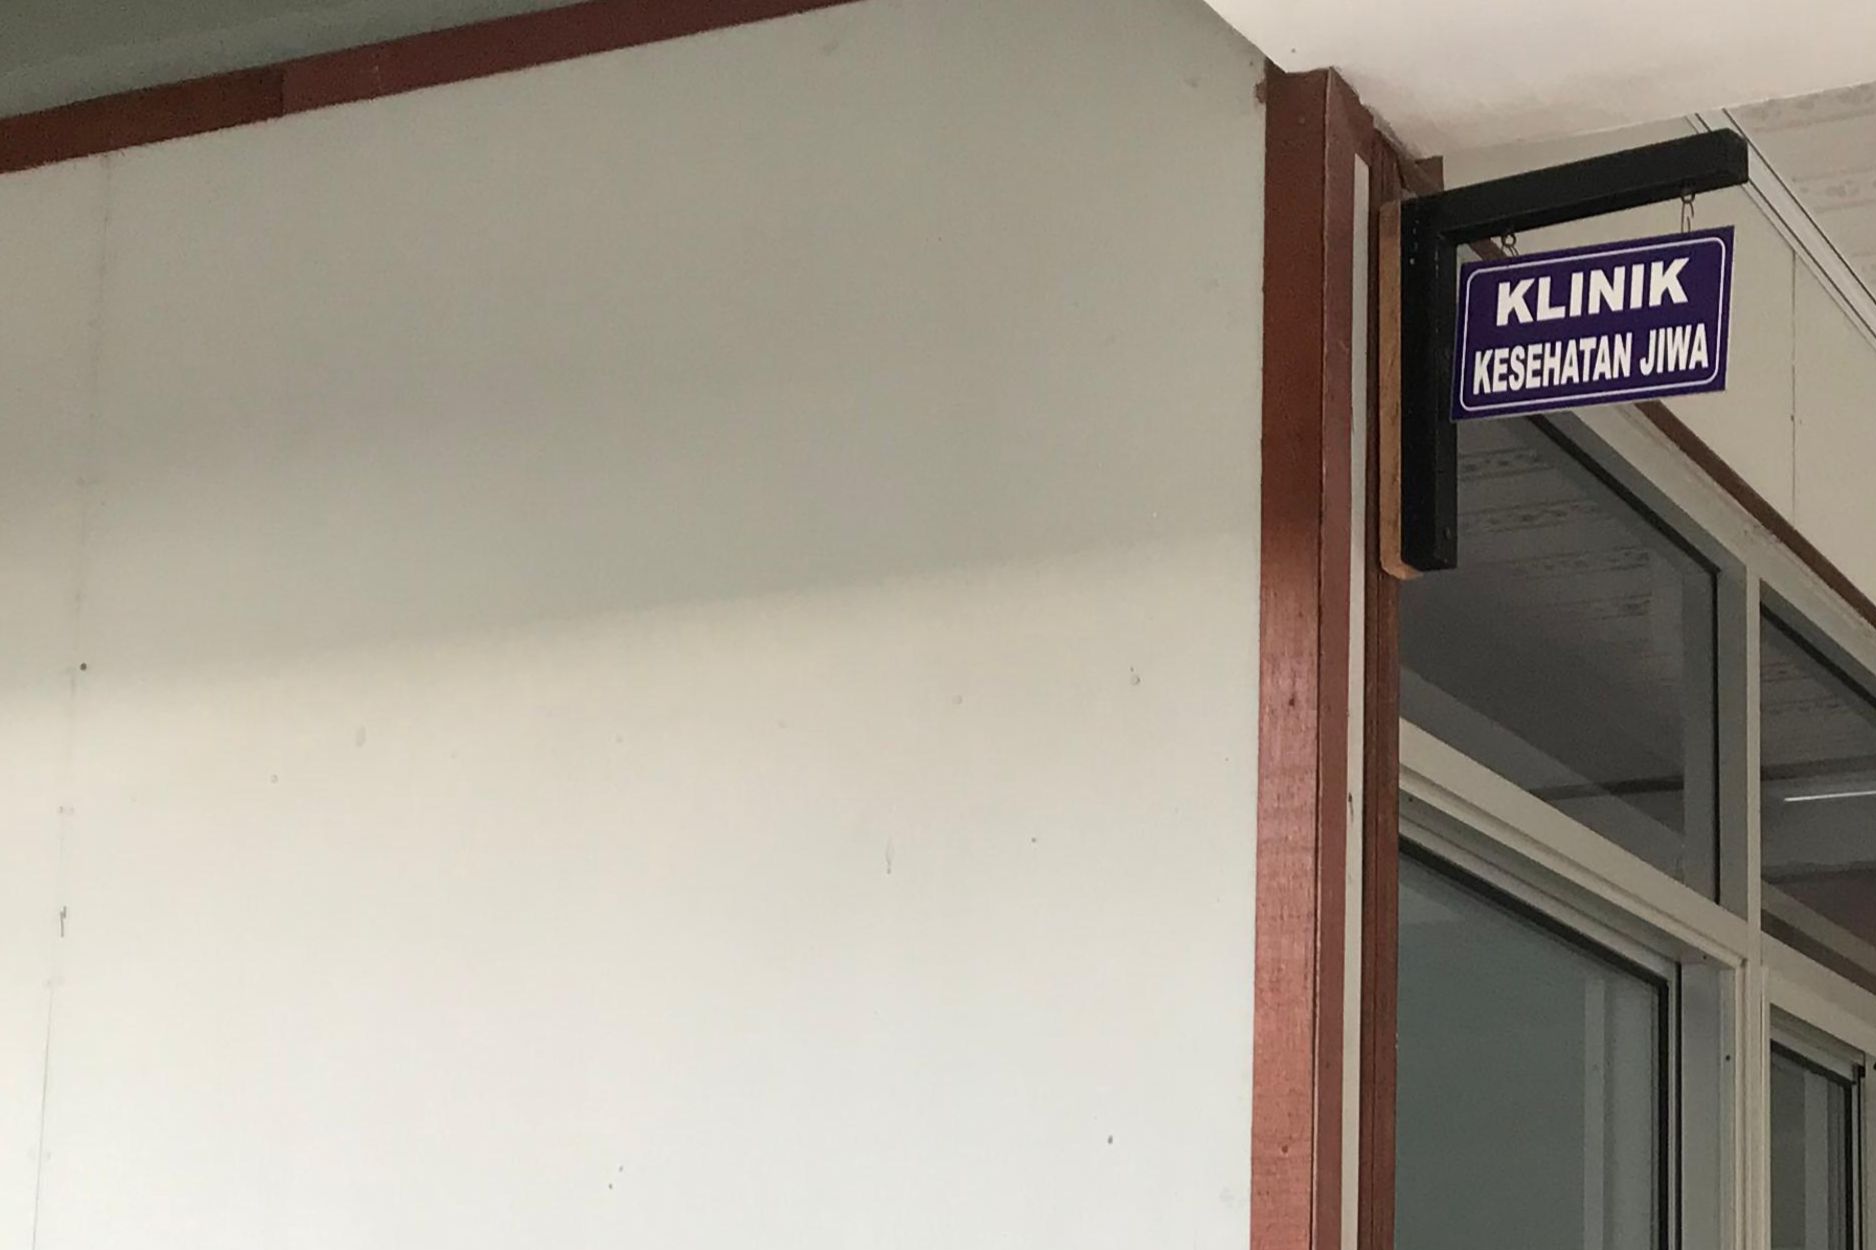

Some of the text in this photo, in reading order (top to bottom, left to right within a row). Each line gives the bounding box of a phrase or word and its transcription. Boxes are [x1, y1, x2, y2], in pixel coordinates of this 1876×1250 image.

[1496, 257, 1690, 327] KLINIK
[1472, 322, 1709, 395] KESEHATAN JIWA
